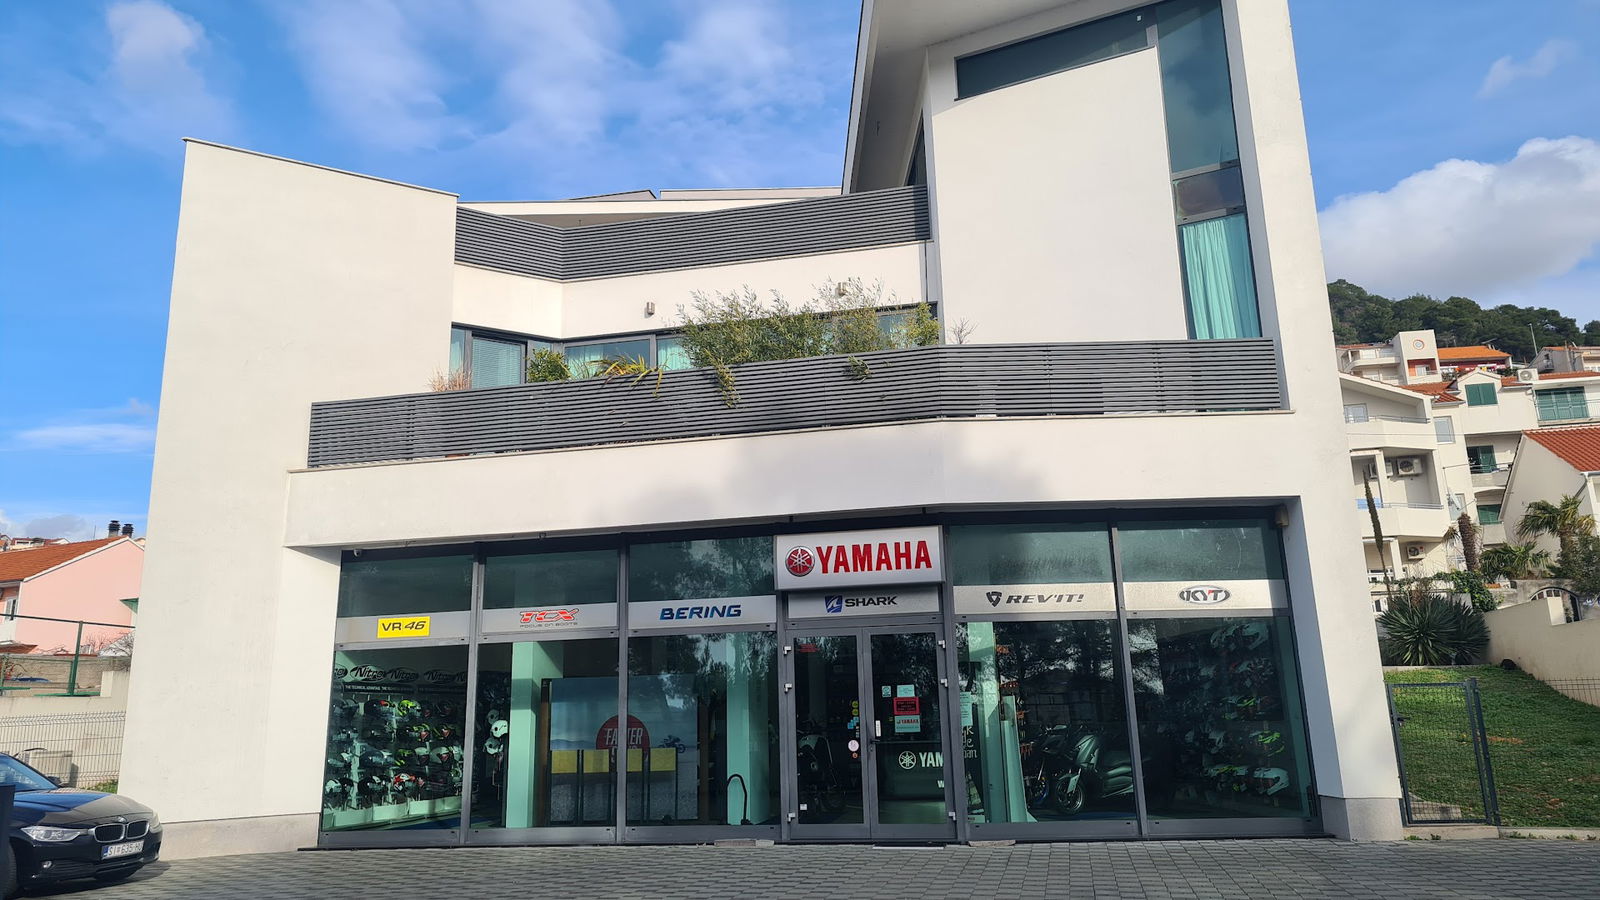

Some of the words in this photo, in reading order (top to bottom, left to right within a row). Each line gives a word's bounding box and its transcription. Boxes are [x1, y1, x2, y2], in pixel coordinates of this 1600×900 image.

[816, 540, 933, 574] YAMAHA
[845, 595, 899, 608] SHARK
[1005, 593, 1084, 604] REV'IT!
[1185, 589, 1223, 602] KYT
[519, 608, 579, 623] TCX
[659, 604, 741, 620] BERING
[381, 622, 402, 632] VR
[404, 620, 427, 631] 46
[354, 666, 385, 680] Nitro
[605, 727, 643, 746] FATER
